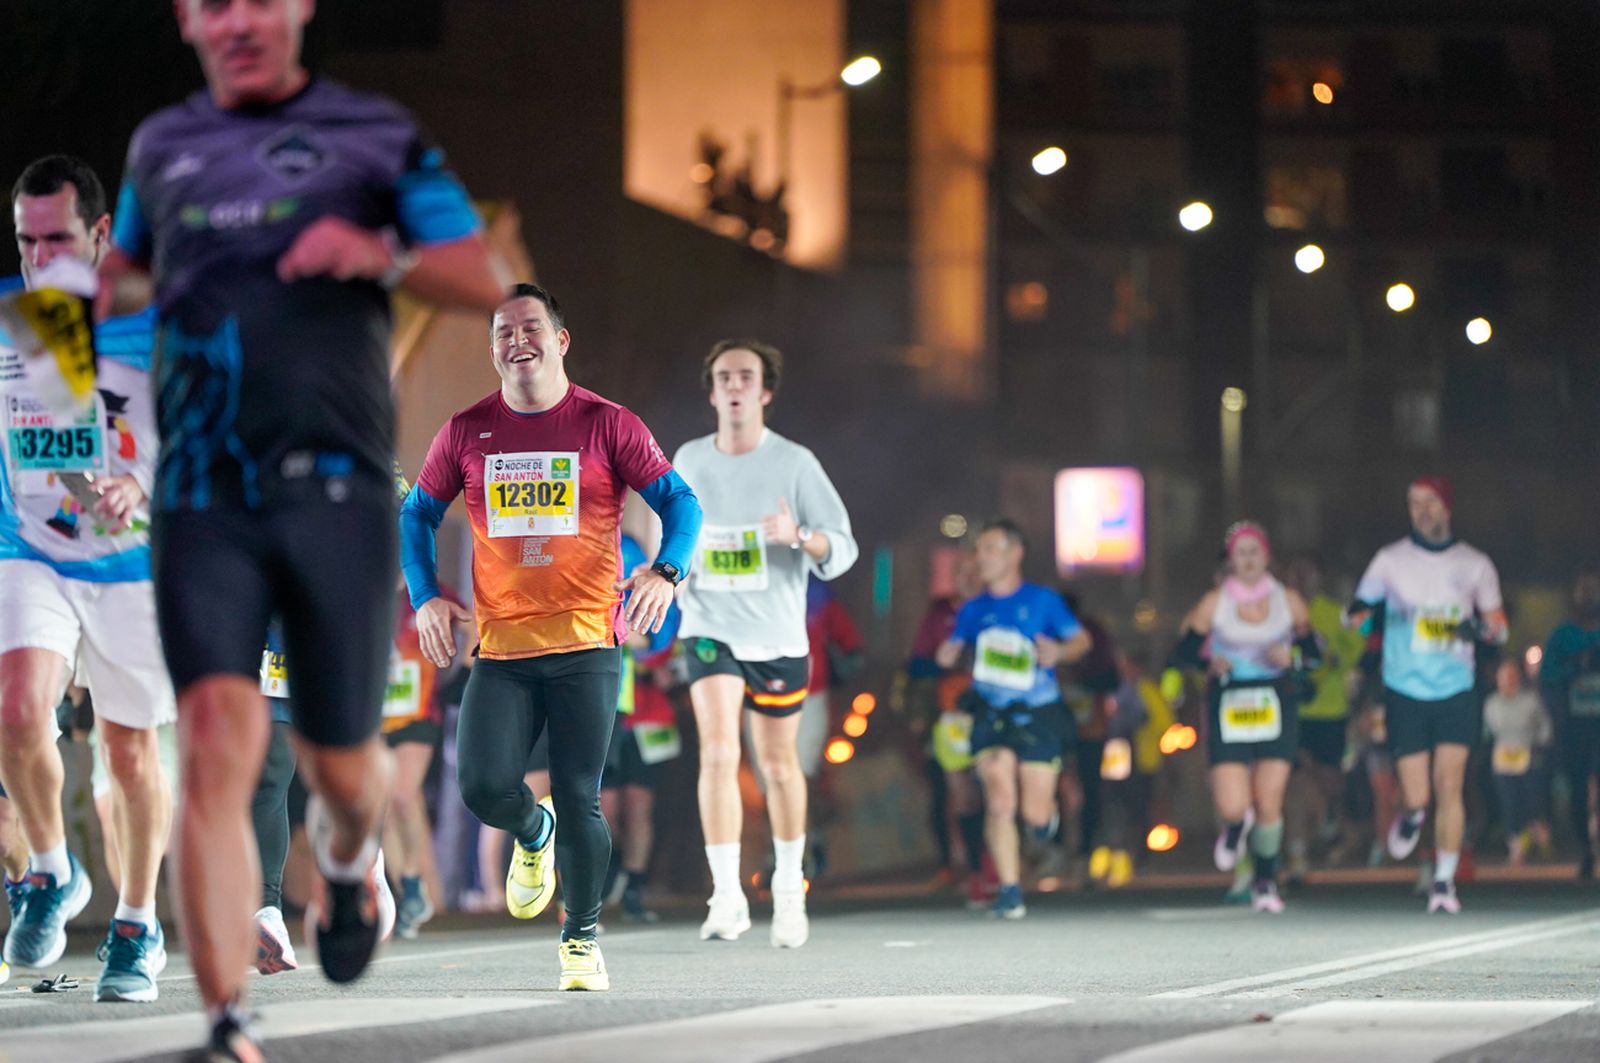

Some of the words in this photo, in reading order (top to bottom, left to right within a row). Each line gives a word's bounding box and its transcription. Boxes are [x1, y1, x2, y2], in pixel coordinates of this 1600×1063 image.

[14, 428, 94, 459] 13295
[504, 461, 531, 471] NOCHE
[533, 461, 543, 470] DE
[494, 472, 511, 482] SAN
[496, 482, 567, 507] 12302
